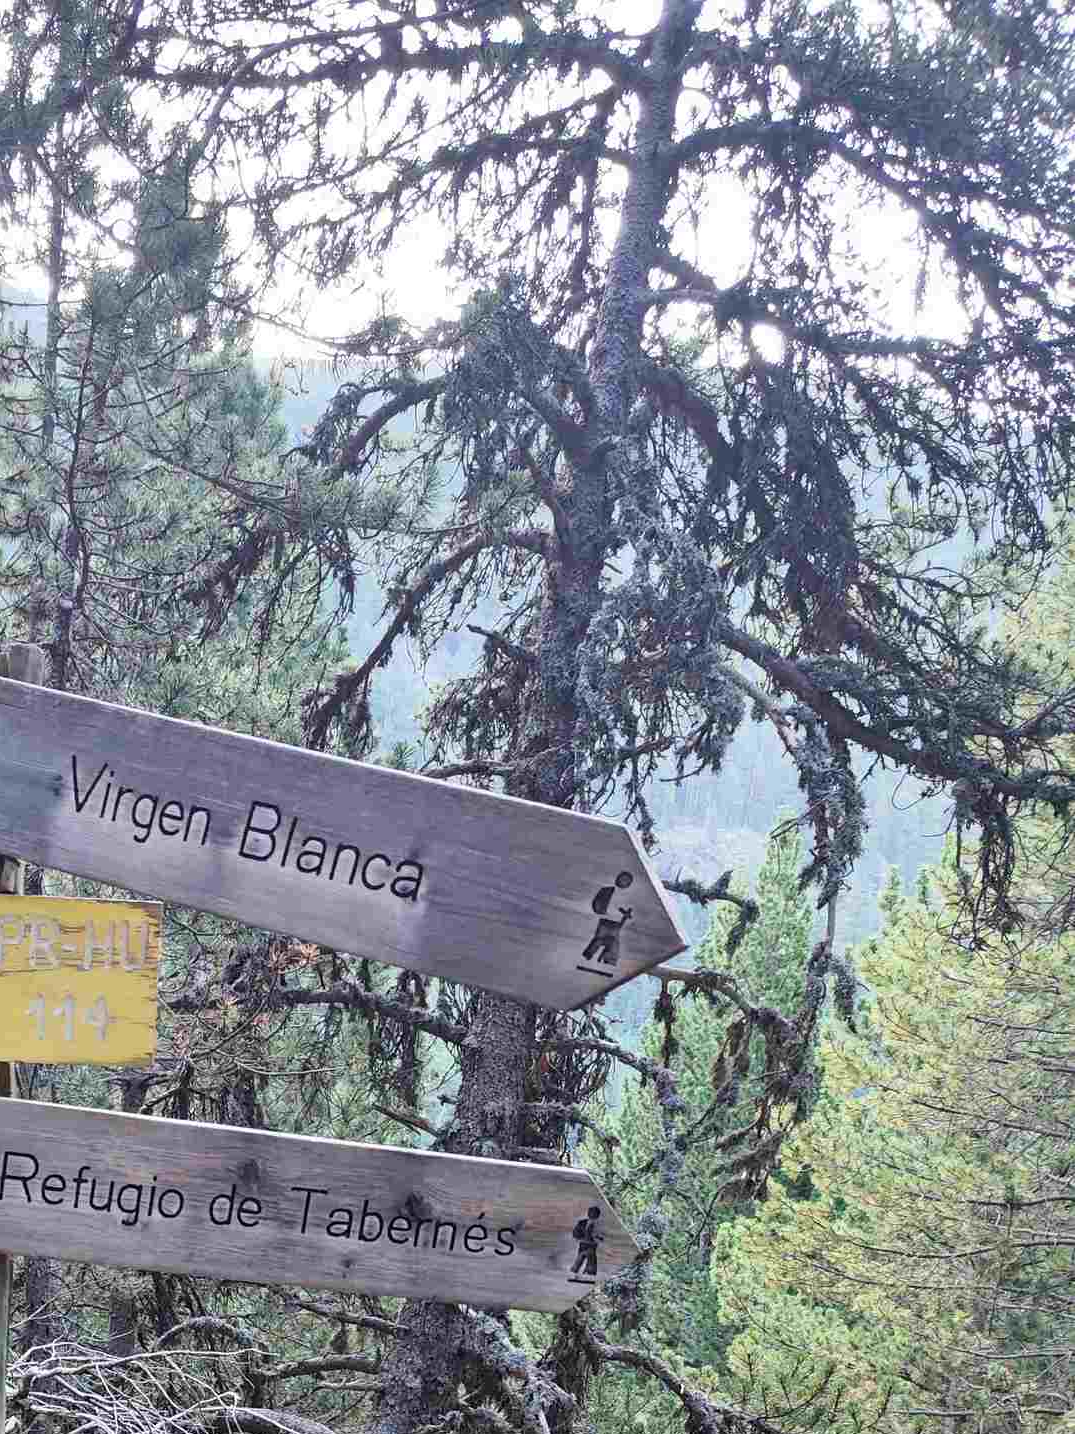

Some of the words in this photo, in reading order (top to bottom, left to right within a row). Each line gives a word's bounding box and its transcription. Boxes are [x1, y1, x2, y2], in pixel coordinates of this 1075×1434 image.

[70, 753, 212, 845] Virgen
[237, 800, 426, 902] Blanca
[27, 991, 112, 1042] 114
[209, 1183, 263, 1228] de
[290, 1186, 518, 1257] Tabernés
